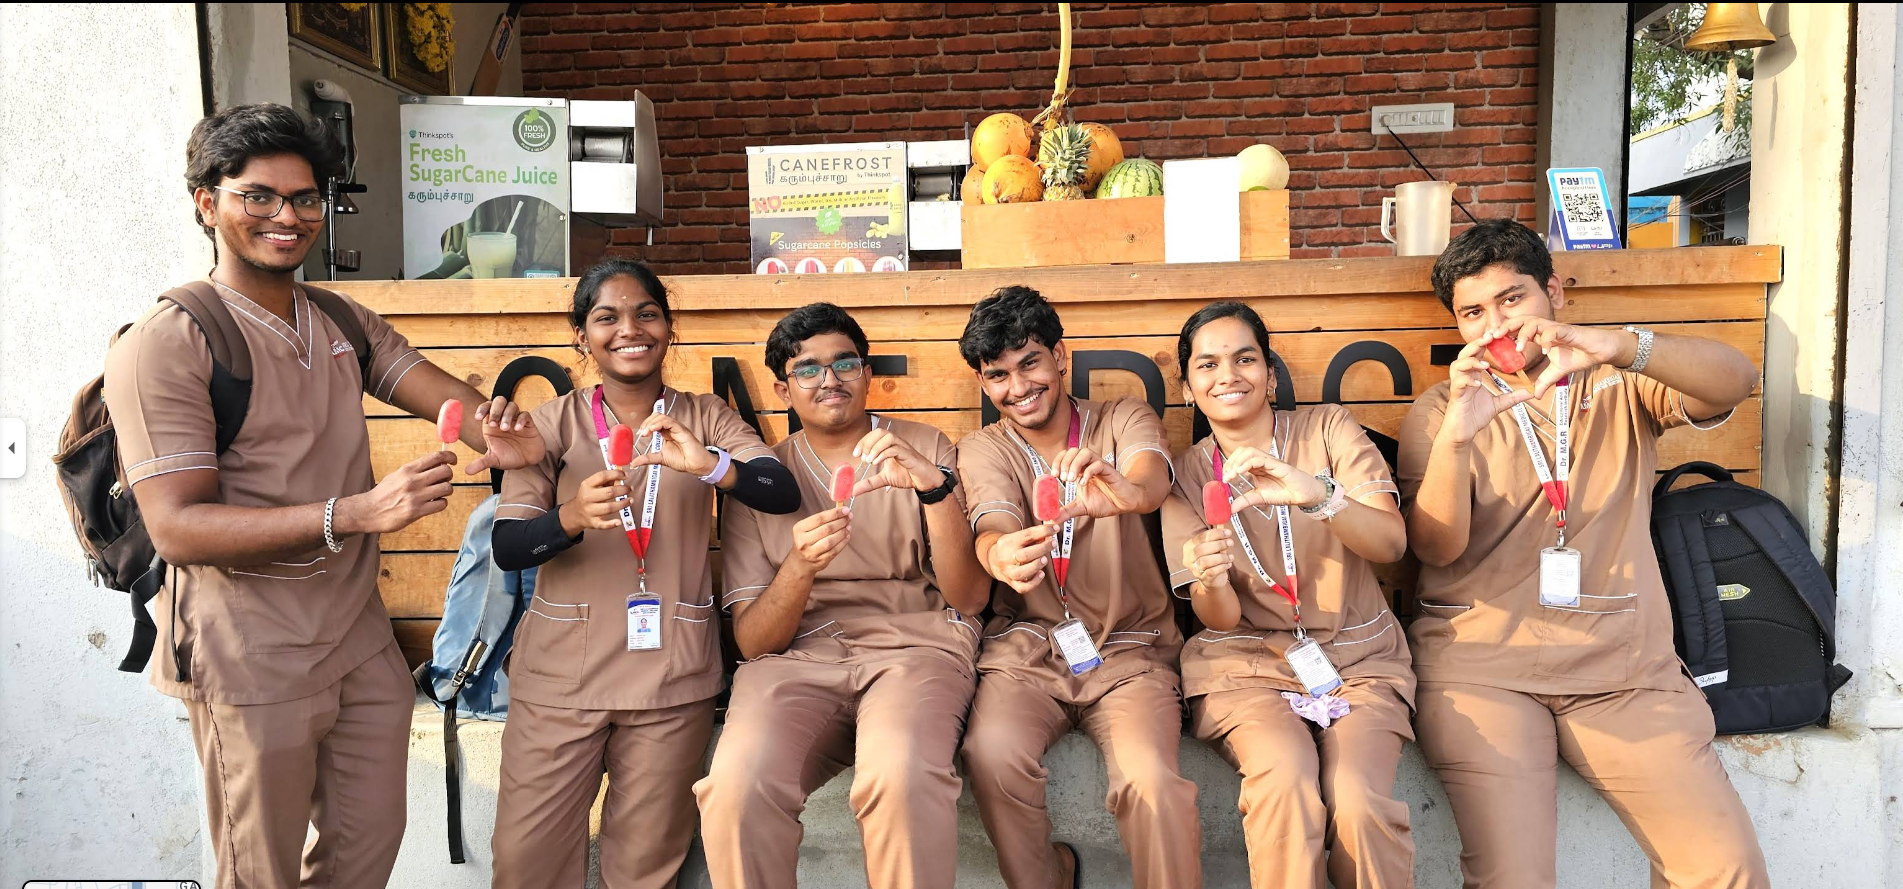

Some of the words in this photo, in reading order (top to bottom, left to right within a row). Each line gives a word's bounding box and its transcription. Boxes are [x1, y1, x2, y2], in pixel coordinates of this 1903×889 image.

[418, 131, 454, 140] Thinkspot's
[409, 143, 466, 162] Fresh
[779, 157, 892, 171] CANEFROST
[409, 164, 507, 187] SugarCane
[511, 165, 558, 185] Juice
[754, 195, 782, 214] NO
[778, 240, 831, 252] Sugarcane
[834, 239, 882, 251] Popsicles
[1560, 431, 1568, 454] M.G.R
[1560, 456, 1568, 467] Dr.
